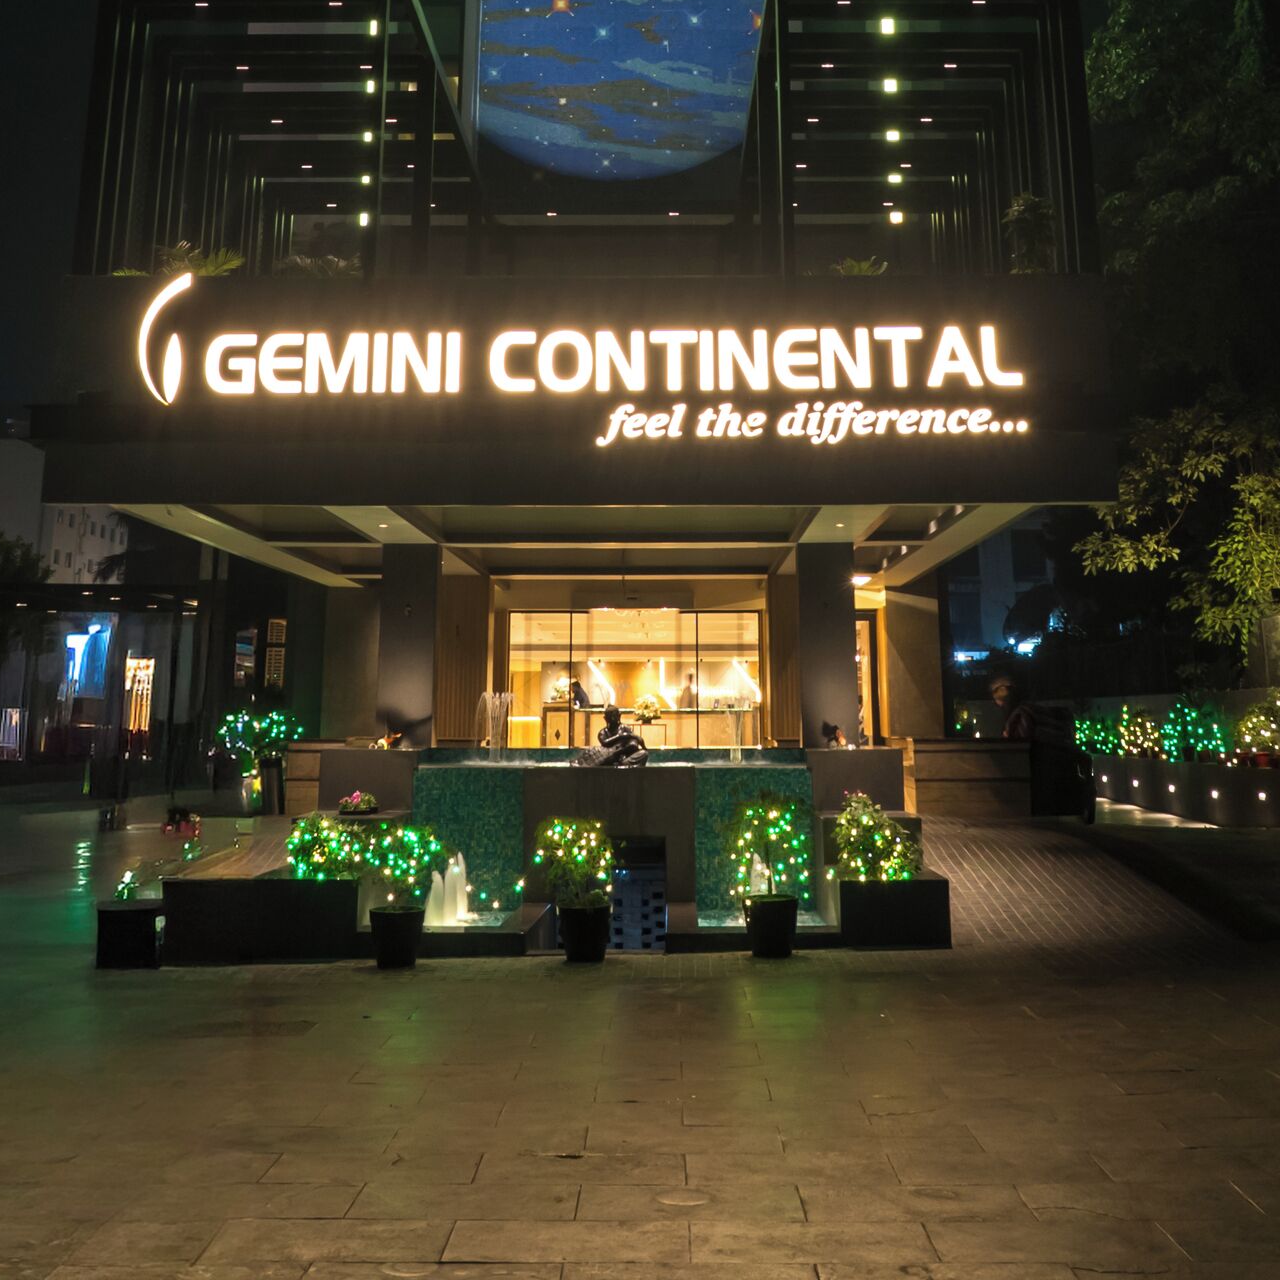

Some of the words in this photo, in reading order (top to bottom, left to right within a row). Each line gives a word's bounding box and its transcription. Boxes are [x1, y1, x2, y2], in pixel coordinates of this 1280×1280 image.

[204, 331, 462, 395] GEMINI
[488, 325, 1024, 394] CONTINENTAL
[595, 402, 687, 447] feel
[695, 402, 767, 438] the
[776, 401, 1029, 445] difference...
